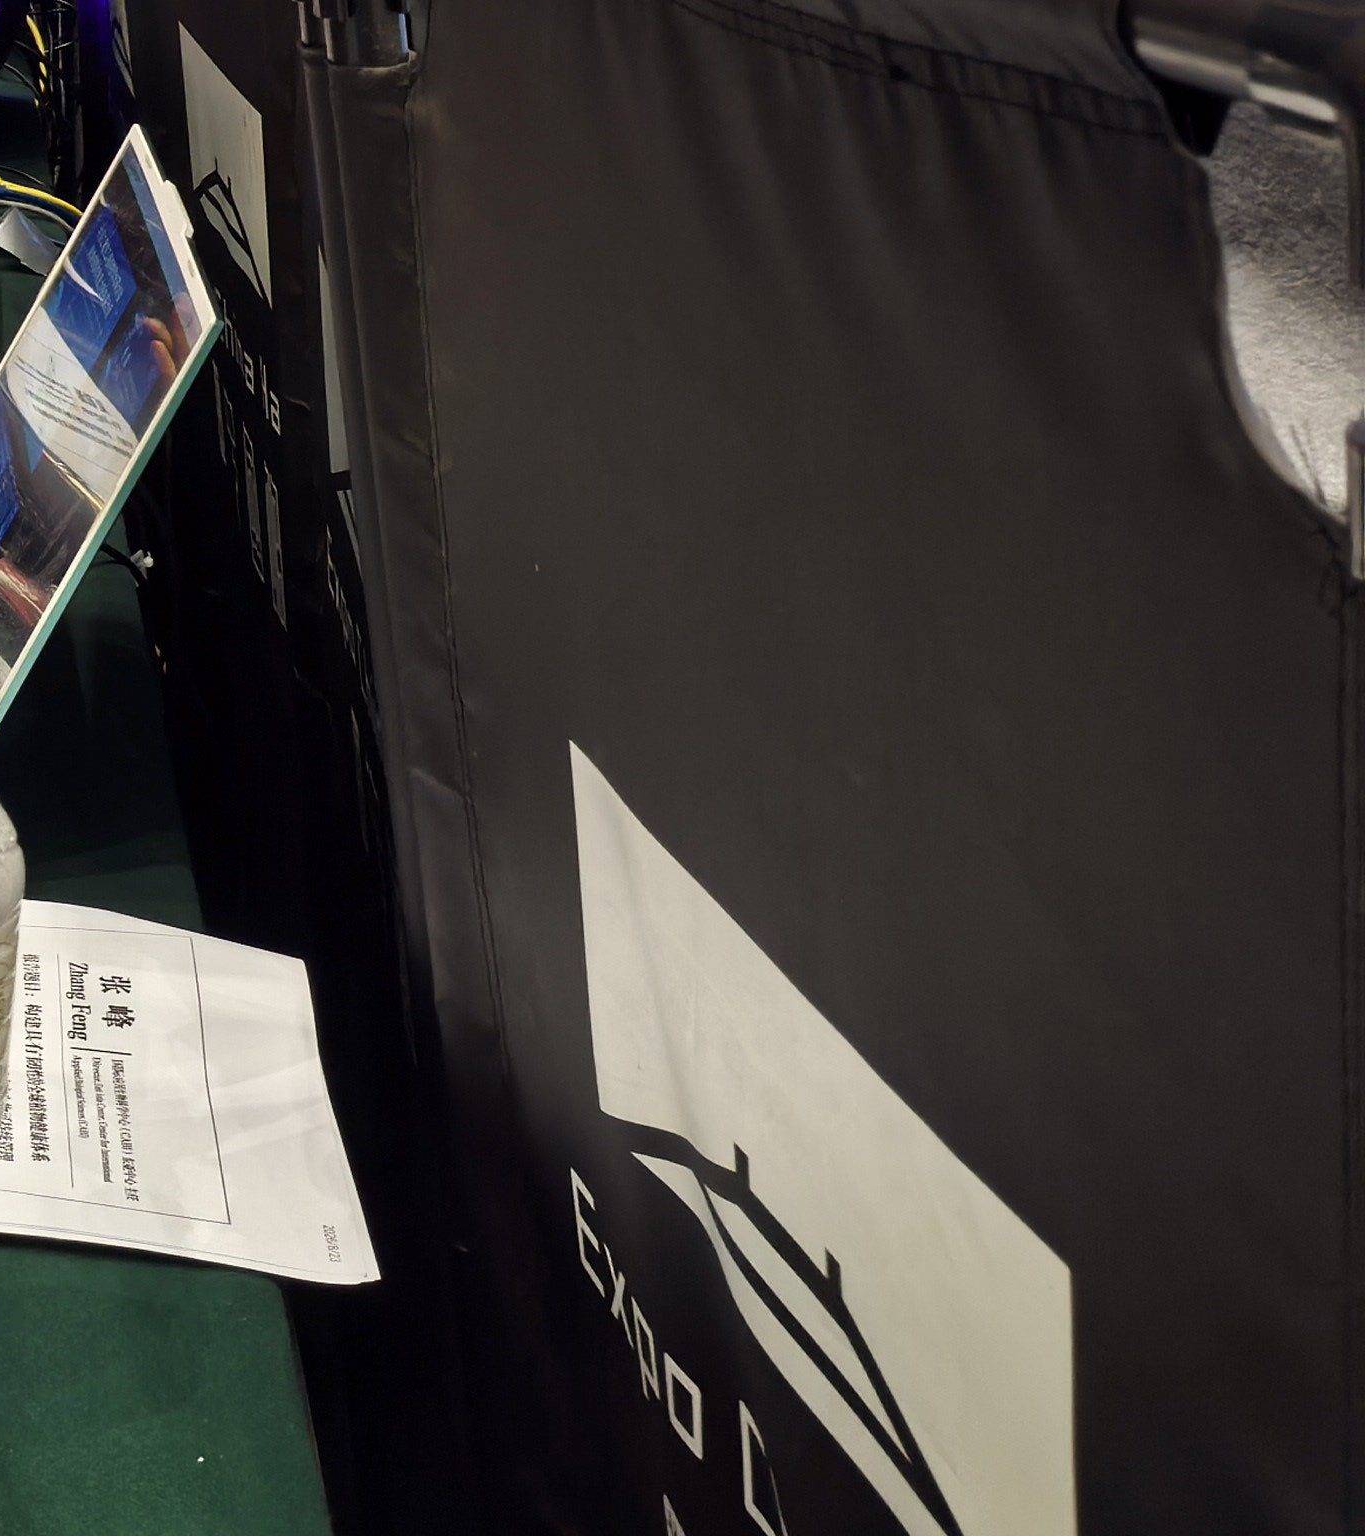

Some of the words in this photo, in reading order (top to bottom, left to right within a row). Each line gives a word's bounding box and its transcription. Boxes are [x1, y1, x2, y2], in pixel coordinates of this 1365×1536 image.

[66, 962, 92, 1000] Zhang
[99, 975, 132, 994] 张
[67, 1003, 93, 1041] Feng
[101, 1003, 136, 1029] 峰
